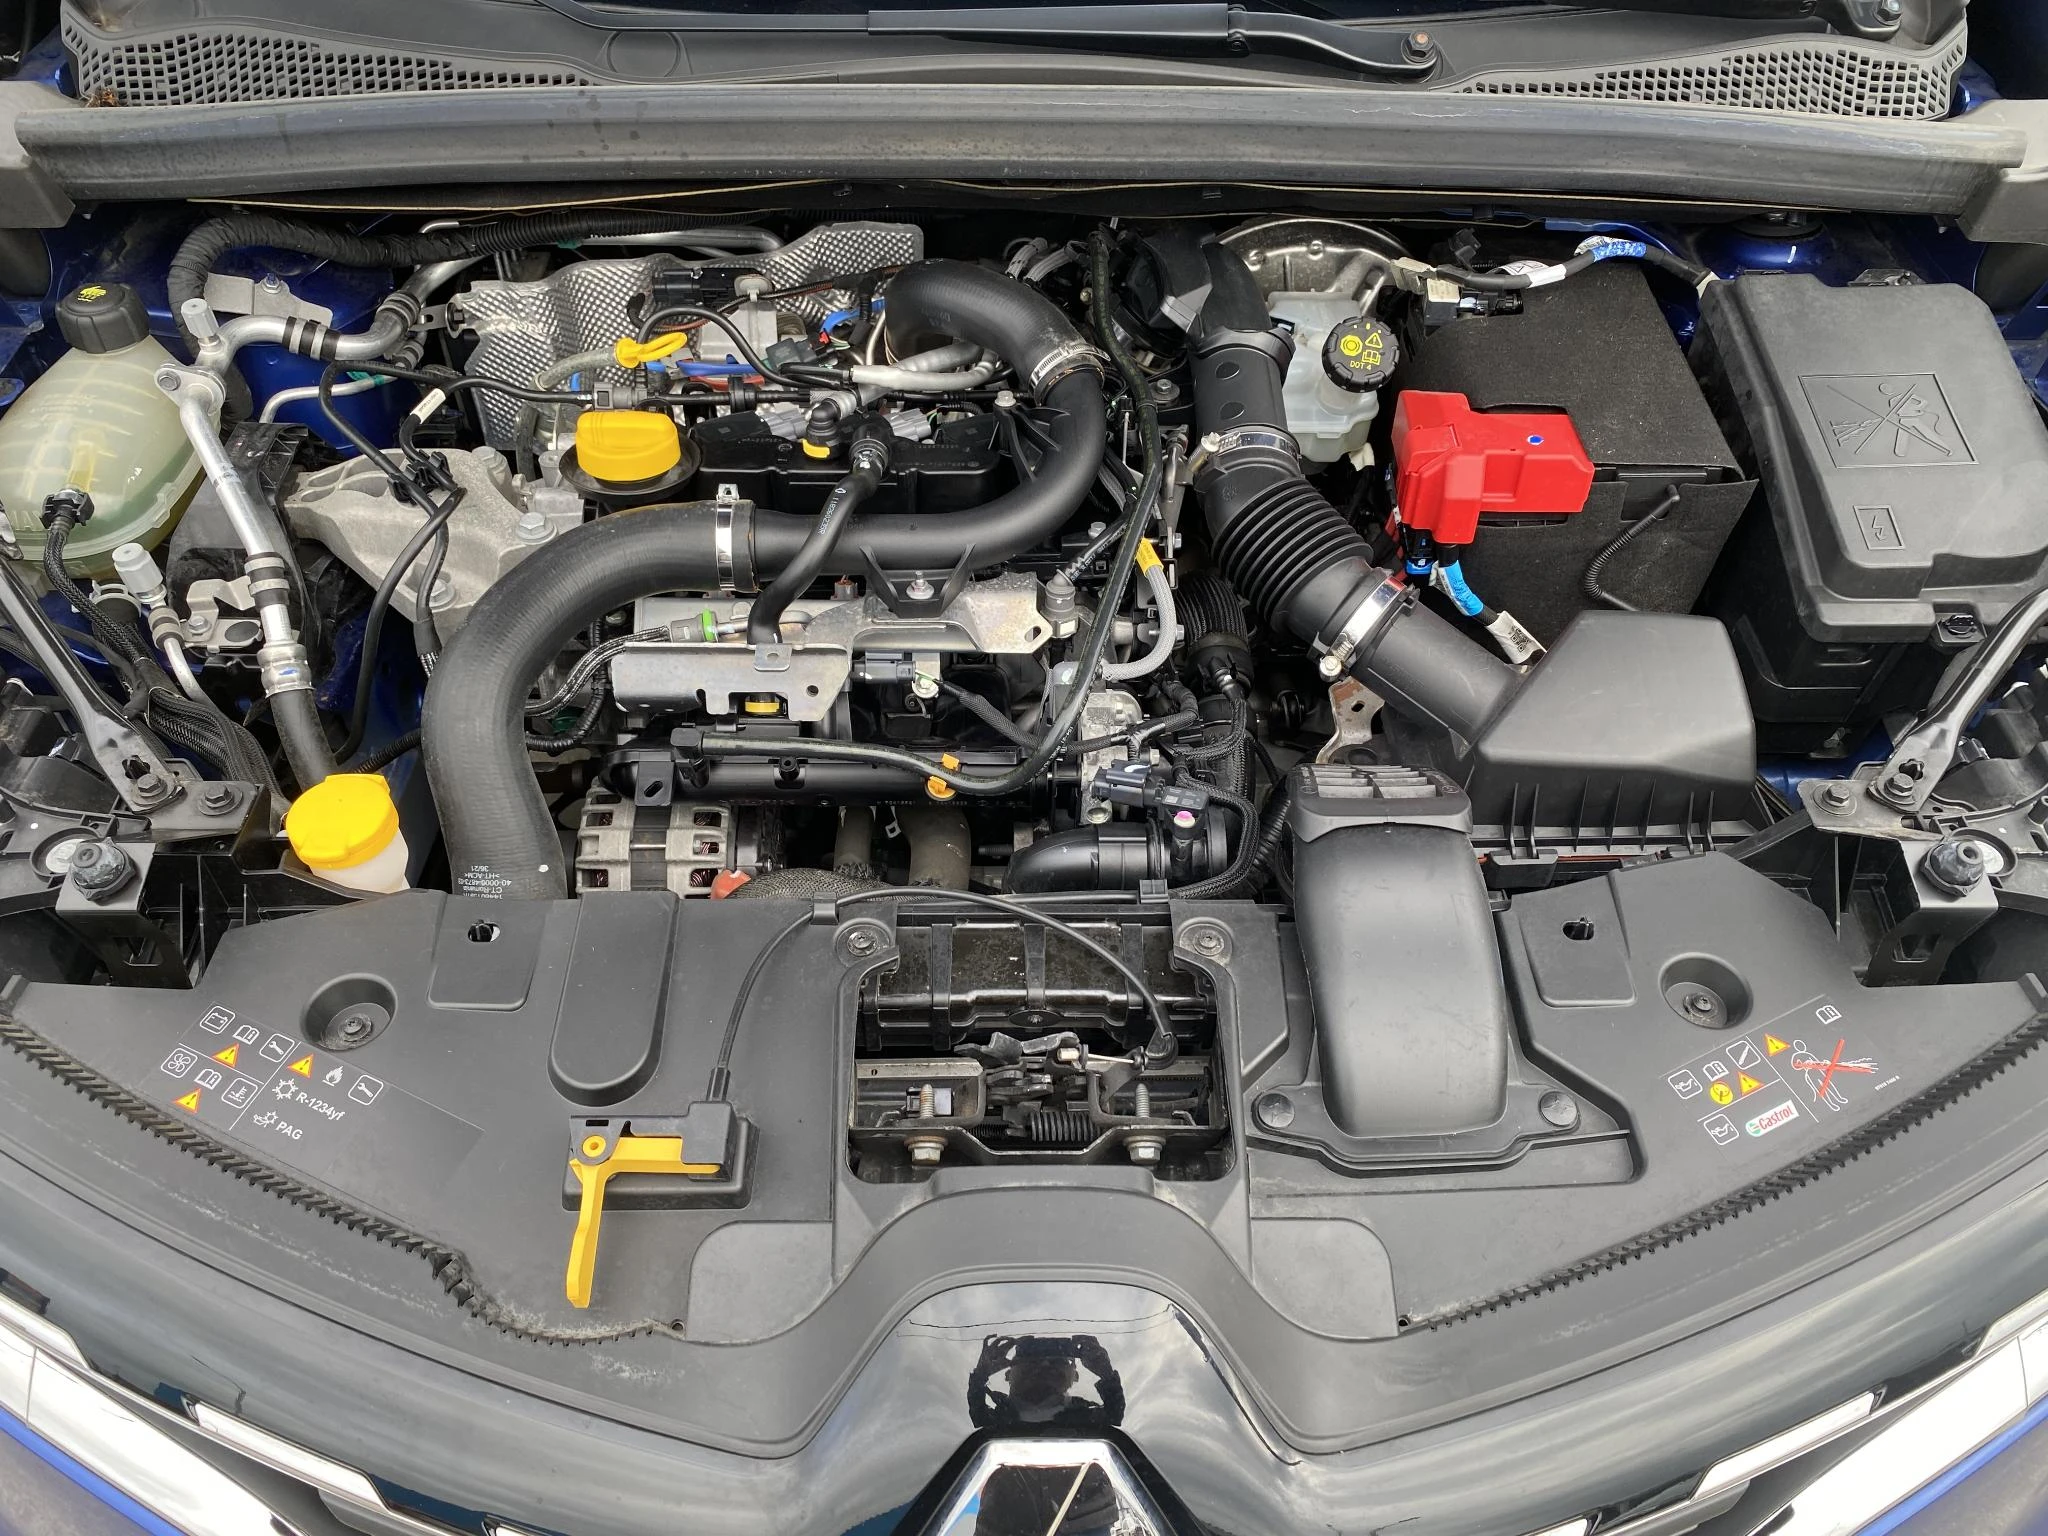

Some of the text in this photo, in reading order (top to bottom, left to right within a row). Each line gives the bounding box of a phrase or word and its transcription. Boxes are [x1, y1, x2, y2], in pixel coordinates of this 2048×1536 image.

[1350, 360, 1365, 369] DOT
[296, 1092, 346, 1121] R-1234yf
[1758, 1105, 1794, 1130] Castrol
[275, 1121, 303, 1140] PAG
